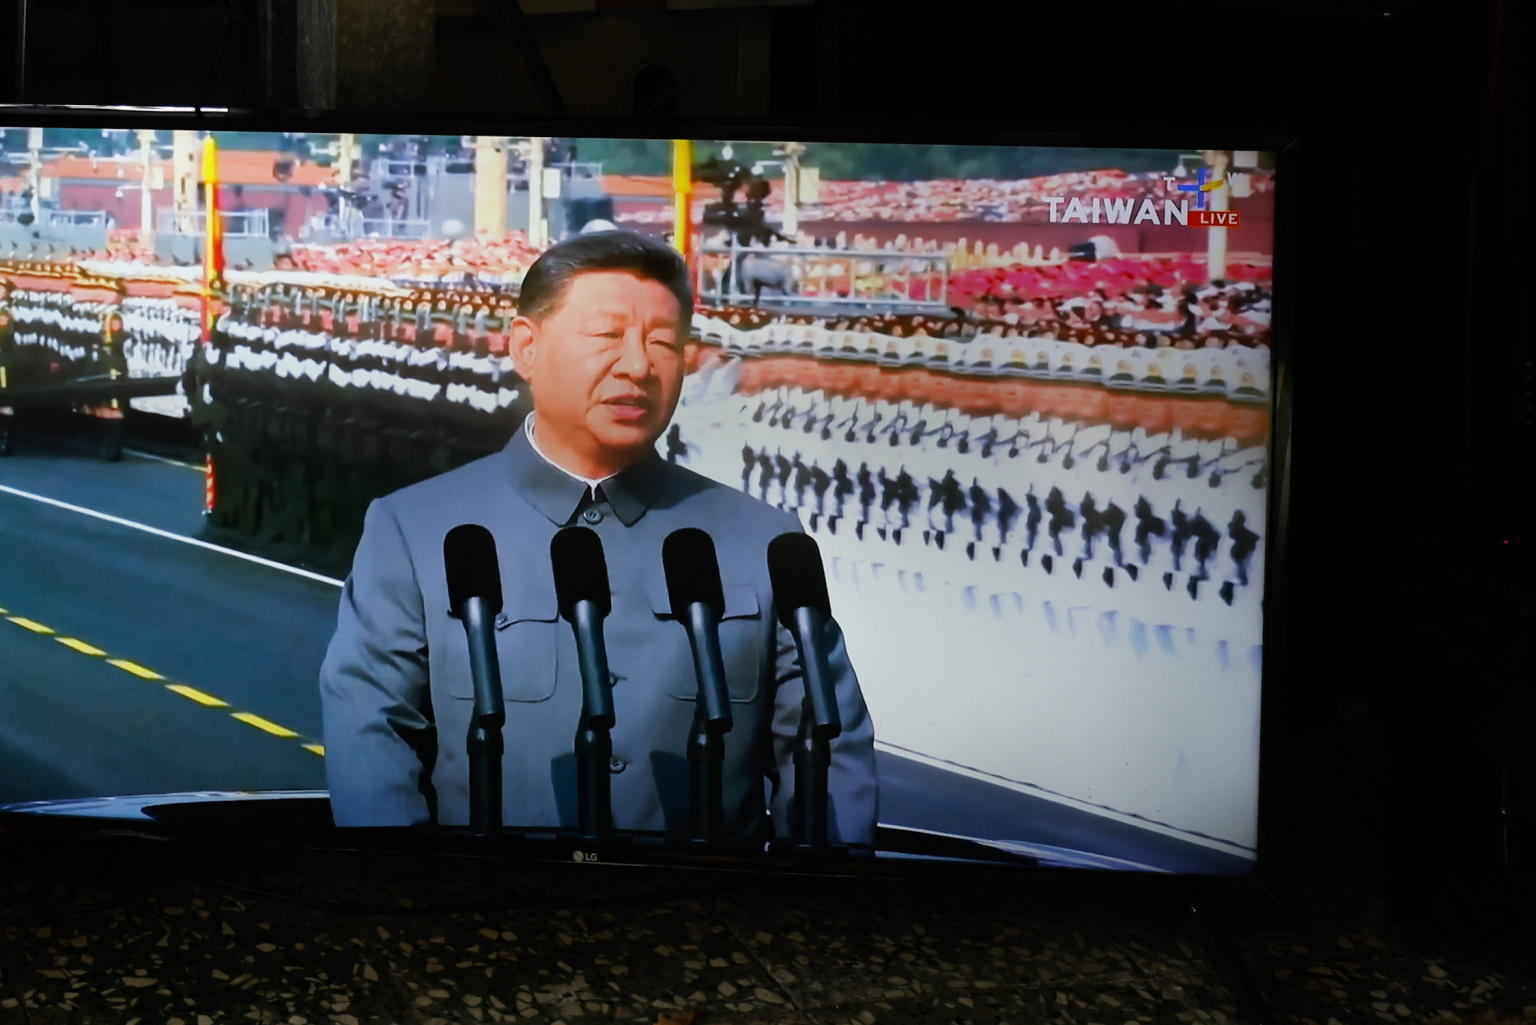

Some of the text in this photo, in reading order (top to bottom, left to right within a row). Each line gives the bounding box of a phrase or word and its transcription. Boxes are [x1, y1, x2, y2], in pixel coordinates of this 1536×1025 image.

[1042, 196, 1238, 226] TAIWAN LIVE
[584, 852, 598, 862] LG
